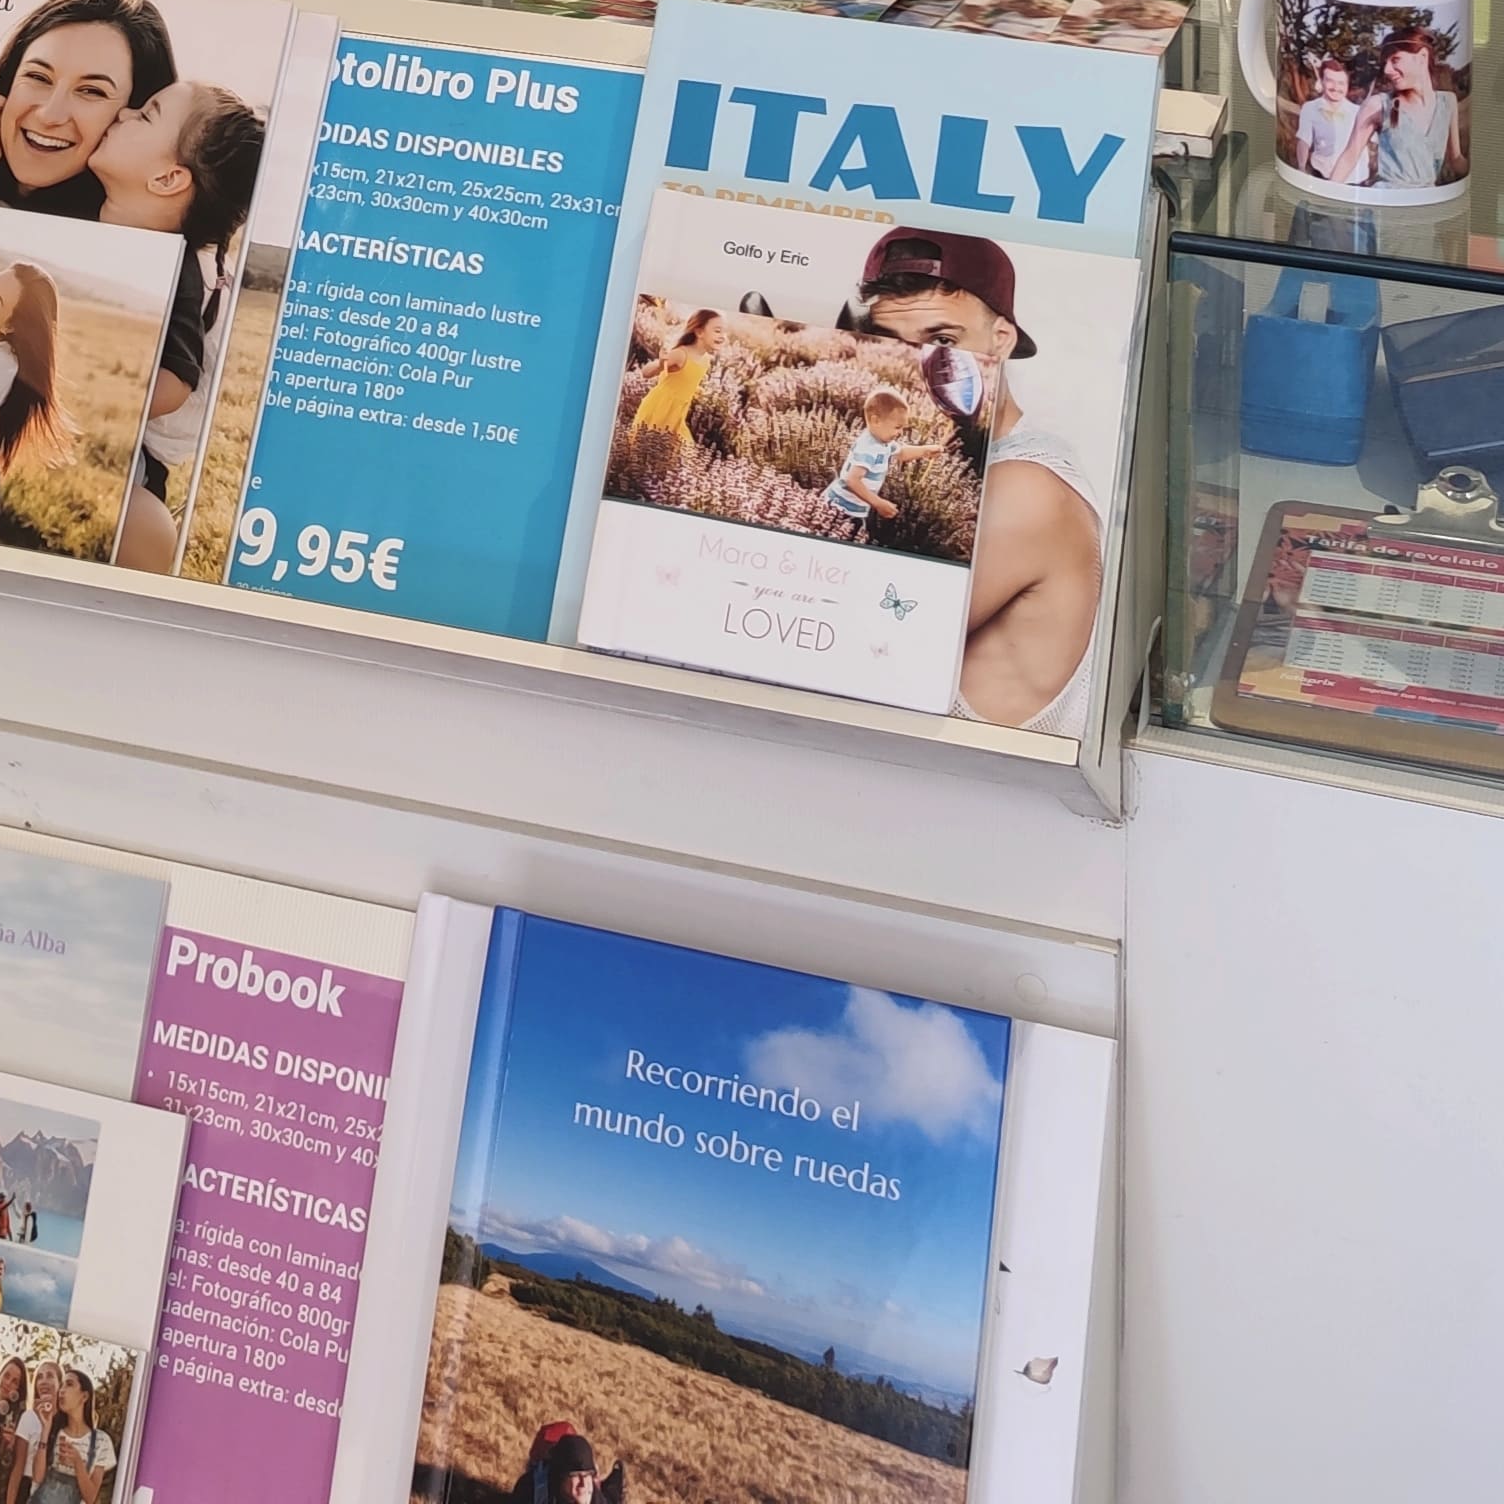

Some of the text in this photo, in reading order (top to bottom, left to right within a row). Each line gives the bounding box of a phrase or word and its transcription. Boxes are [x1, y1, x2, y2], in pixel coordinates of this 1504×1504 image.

[486, 67, 580, 114] Plus
[665, 78, 1126, 225] ITALY
[722, 239, 809, 269] Golfo y Eric
[723, 601, 836, 654] LOVED
[21, 926, 66, 956] Alba
[166, 936, 346, 1017] Probook
[625, 1048, 860, 1132] Recorriendo el
[573, 1099, 902, 1203] mundo sobre ruedas
